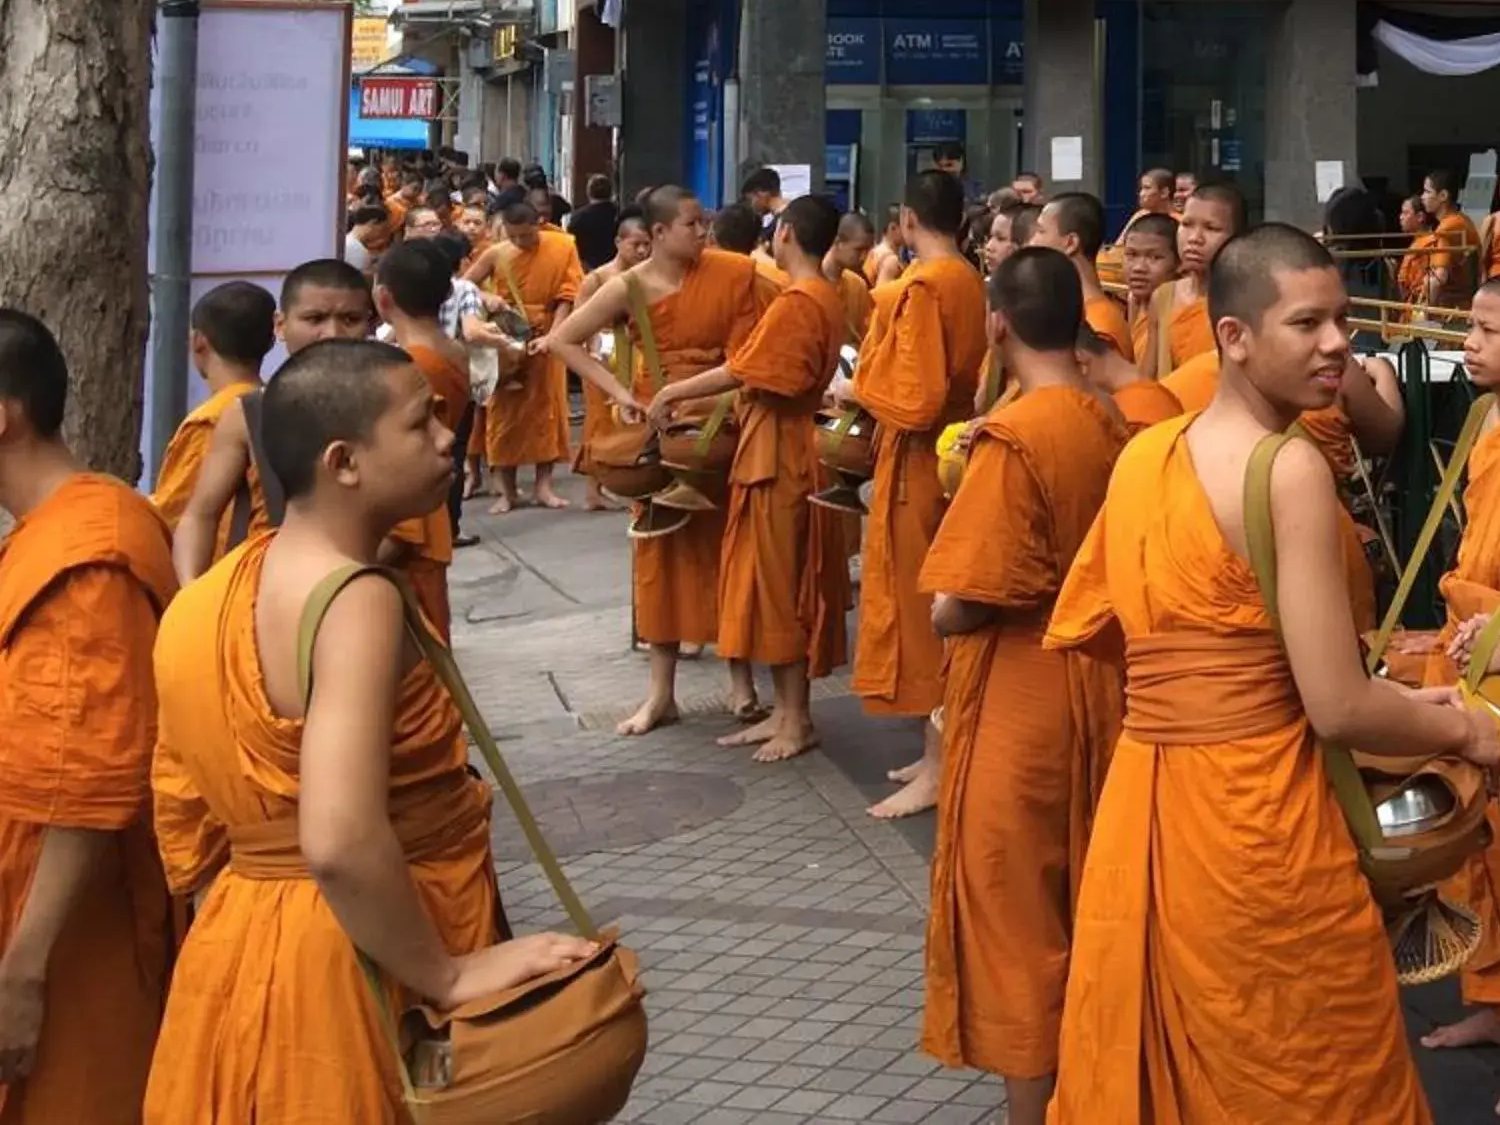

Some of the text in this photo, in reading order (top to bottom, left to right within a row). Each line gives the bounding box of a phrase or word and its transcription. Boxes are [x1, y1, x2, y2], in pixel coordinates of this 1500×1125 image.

[893, 34, 932, 49] ATM
[362, 86, 434, 116] SAMUI ART
